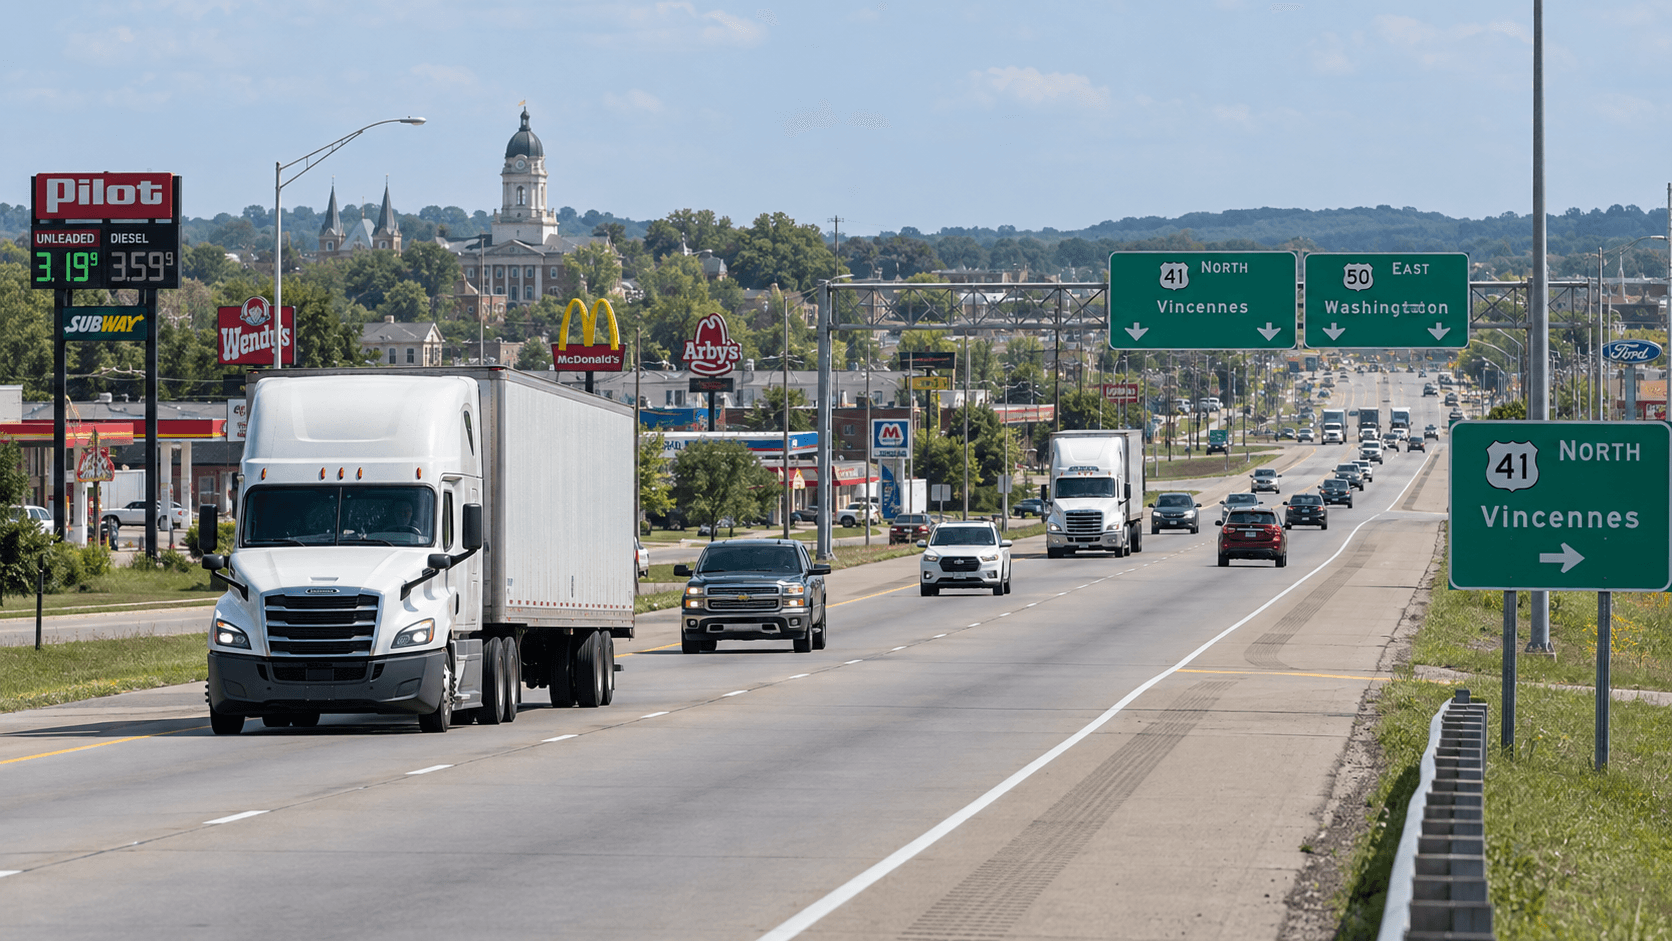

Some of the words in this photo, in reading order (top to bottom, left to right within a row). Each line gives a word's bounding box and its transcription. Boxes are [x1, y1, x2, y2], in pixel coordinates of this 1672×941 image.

[46, 178, 163, 214] Pilot
[36, 233, 95, 244] UNLEADED
[110, 233, 149, 244] DIESEL
[1164, 268, 1183, 284] 41
[1201, 261, 1248, 273] NORTH
[1347, 269, 1370, 285] 50
[1392, 262, 1430, 275] EAST
[1156, 300, 1249, 314] Vincennes
[64, 313, 145, 333] SUBWAY
[557, 354, 620, 364] McDonald's
[682, 341, 739, 364] Arby's
[1610, 343, 1650, 360] Ford
[1495, 453, 1527, 480] 41
[1559, 440, 1641, 461] NORTH
[1480, 505, 1640, 529] Vincennes
